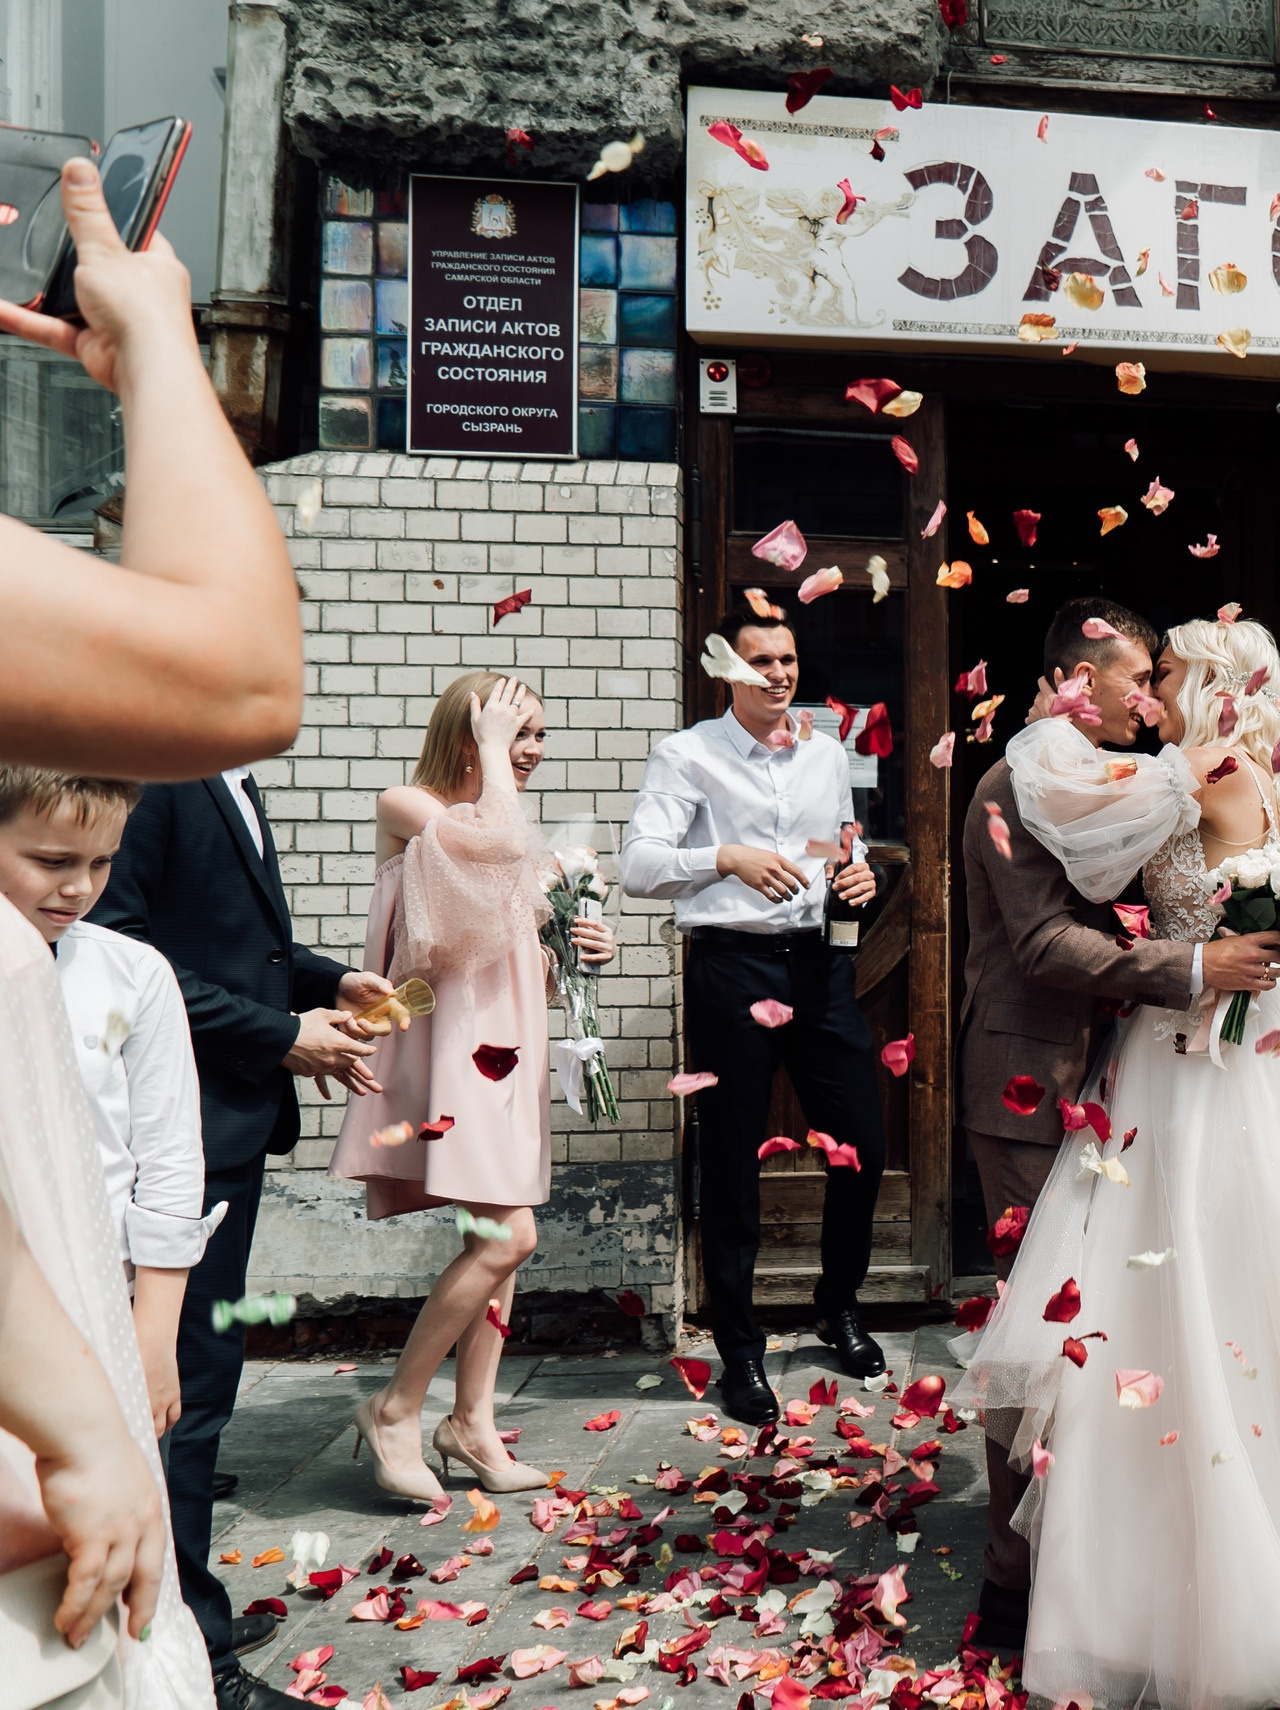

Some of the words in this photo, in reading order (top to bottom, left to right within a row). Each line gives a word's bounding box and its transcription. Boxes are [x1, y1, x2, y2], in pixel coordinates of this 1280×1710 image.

[431, 250, 488, 260] УПРАВЛЕНИЕ
[490, 253, 525, 262] ЗАПИСИ
[527, 255, 555, 264] АКТОВ
[431, 261, 500, 272] ГРАЖДАНСКОГО
[502, 266, 556, 275] СОСТОЯНИЯ
[445, 273, 499, 284] САМАРСКОЙ
[500, 276, 542, 285] ОБЛАСТИ
[463, 296, 522, 311] ОТДЕЛ
[424, 318, 497, 334] ЗАПИСИ
[501, 322, 561, 336] АКТОВ
[421, 341, 564, 361] ГРАЖДАНСКОГО
[437, 366, 547, 383] СОСТОЯНИЯ
[426, 404, 508, 417] ГОРОДСКОГО
[512, 407, 558, 418] ОКРУГА
[462, 422, 523, 433] СЫЗРАНЬ
